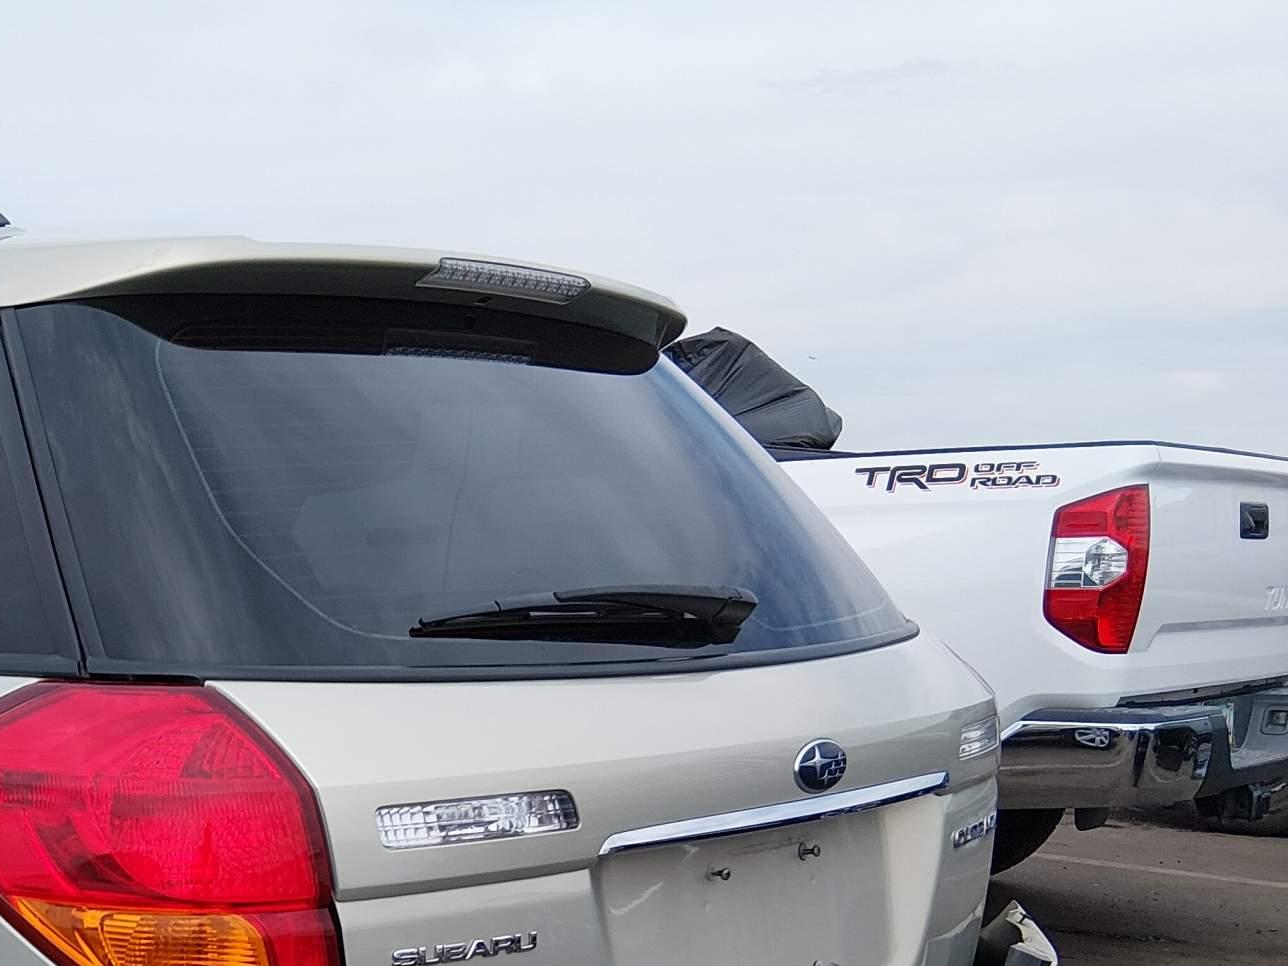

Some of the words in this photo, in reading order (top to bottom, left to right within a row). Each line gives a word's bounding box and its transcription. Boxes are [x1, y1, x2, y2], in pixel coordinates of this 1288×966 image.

[973, 461, 1040, 475] OFF
[855, 462, 969, 493] TRD
[970, 474, 1060, 490] ROAD
